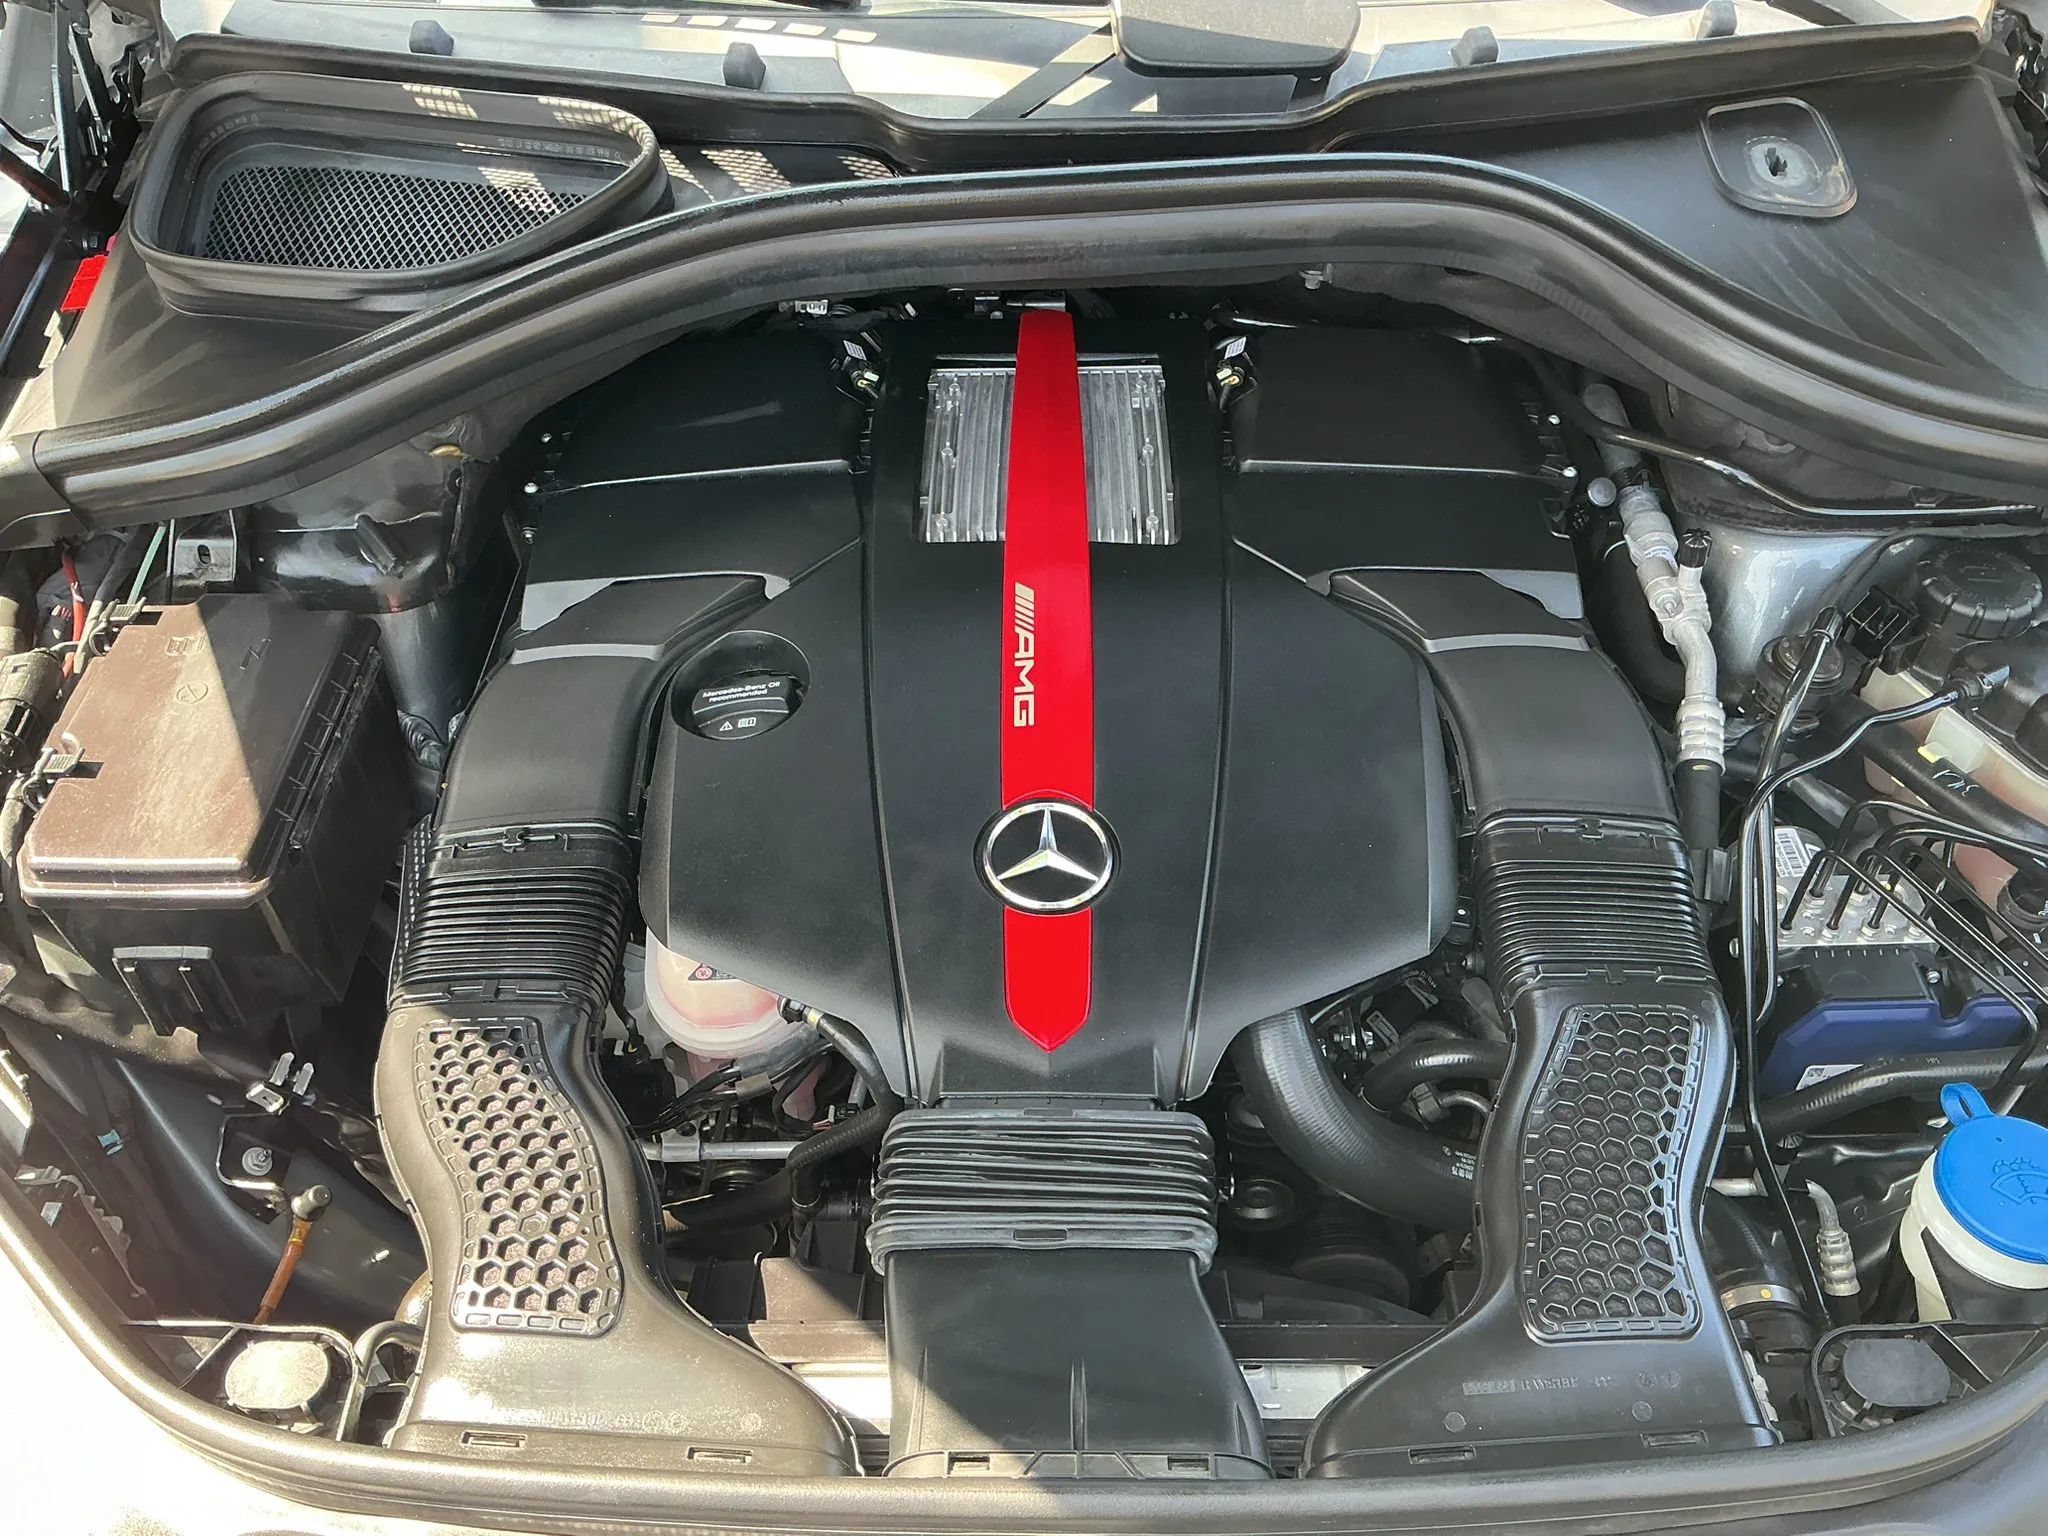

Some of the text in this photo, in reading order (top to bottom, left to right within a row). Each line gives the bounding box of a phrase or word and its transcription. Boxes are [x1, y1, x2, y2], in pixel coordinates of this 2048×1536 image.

[1013, 624, 1035, 728] AMG
[702, 680, 781, 698] Mercedes-Benz Oil
[708, 688, 768, 702] recommended
